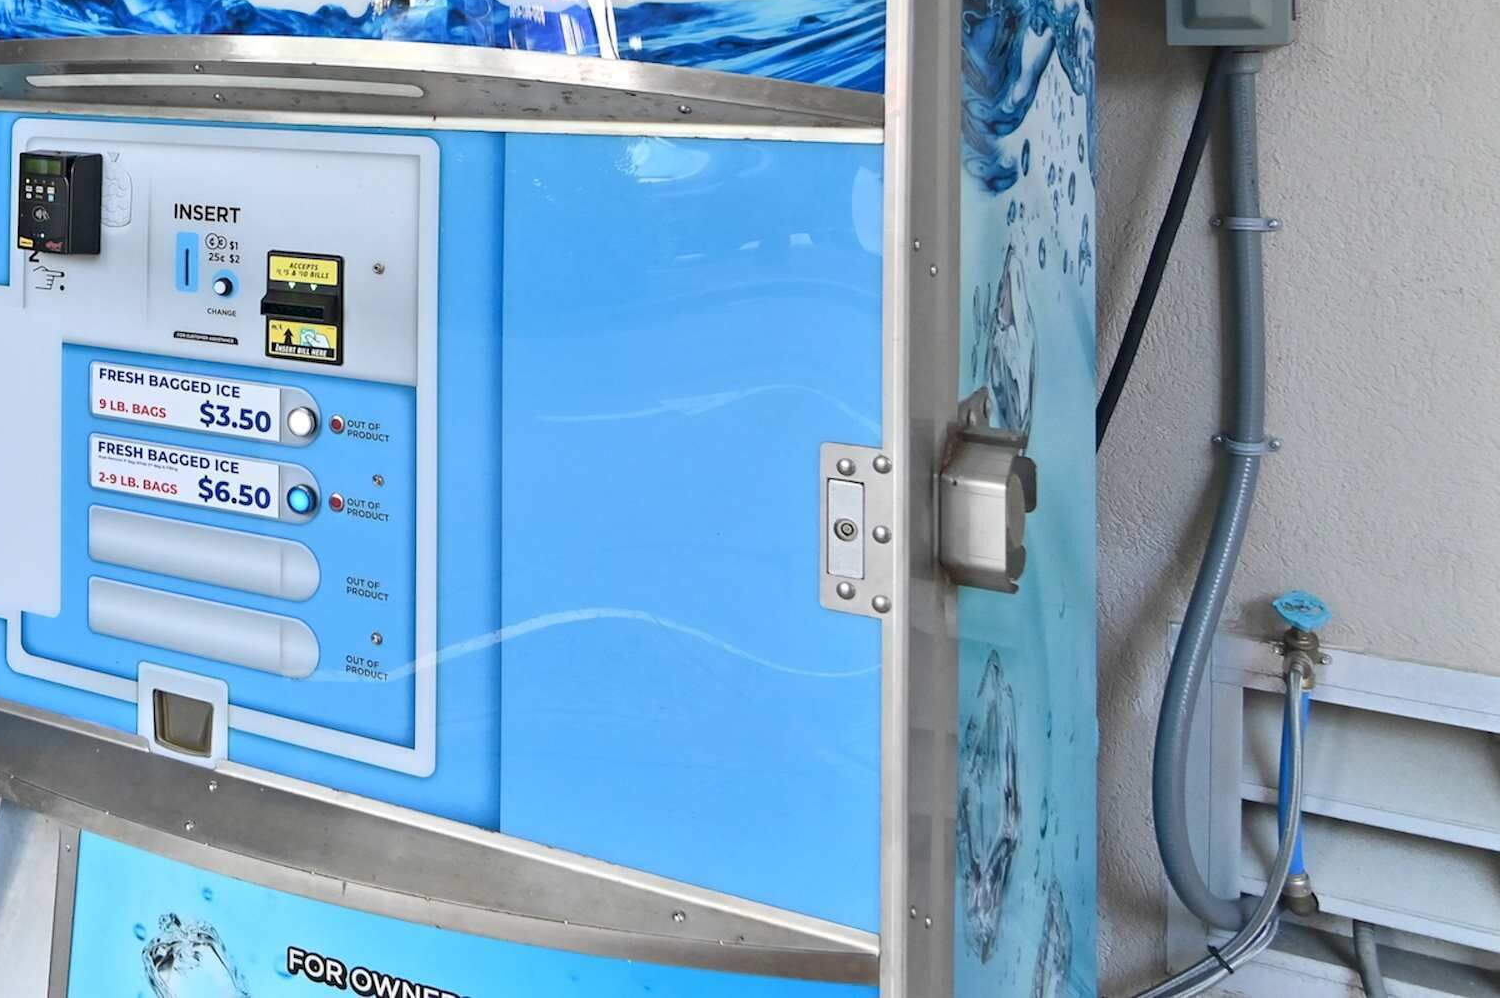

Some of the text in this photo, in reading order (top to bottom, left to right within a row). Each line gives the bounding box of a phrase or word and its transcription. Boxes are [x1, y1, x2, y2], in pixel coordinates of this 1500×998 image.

[174, 202, 241, 223] INSERT
[229, 240, 239, 251] $1
[229, 254, 240, 264] $2
[289, 262, 319, 271] ACCEPTS
[309, 271, 330, 280] BILLS
[206, 307, 237, 318] CHANGE
[275, 343, 328, 358] INSERT BILL HERE
[99, 367, 241, 399] FRESH BAGGED ICE
[99, 398, 167, 419] 9 LB. BAGS
[199, 400, 271, 433] $3.50
[347, 419, 381, 431] OUT OF
[347, 429, 390, 443] PRODUCT
[98, 441, 143, 459] FRESH
[148, 449, 210, 469] BAGGED
[215, 459, 240, 475] ICE
[99, 472, 178, 495] 2-9 LB. BAGS
[197, 475, 271, 509] $6.50
[347, 497, 380, 510] OUT OF
[347, 507, 389, 522] PRODUCT
[346, 576, 380, 590] OUT OF
[346, 586, 389, 602] PRODUCT
[346, 654, 379, 669] OUT OF
[345, 665, 388, 681] PRODUCT
[288, 947, 345, 988] FOR
